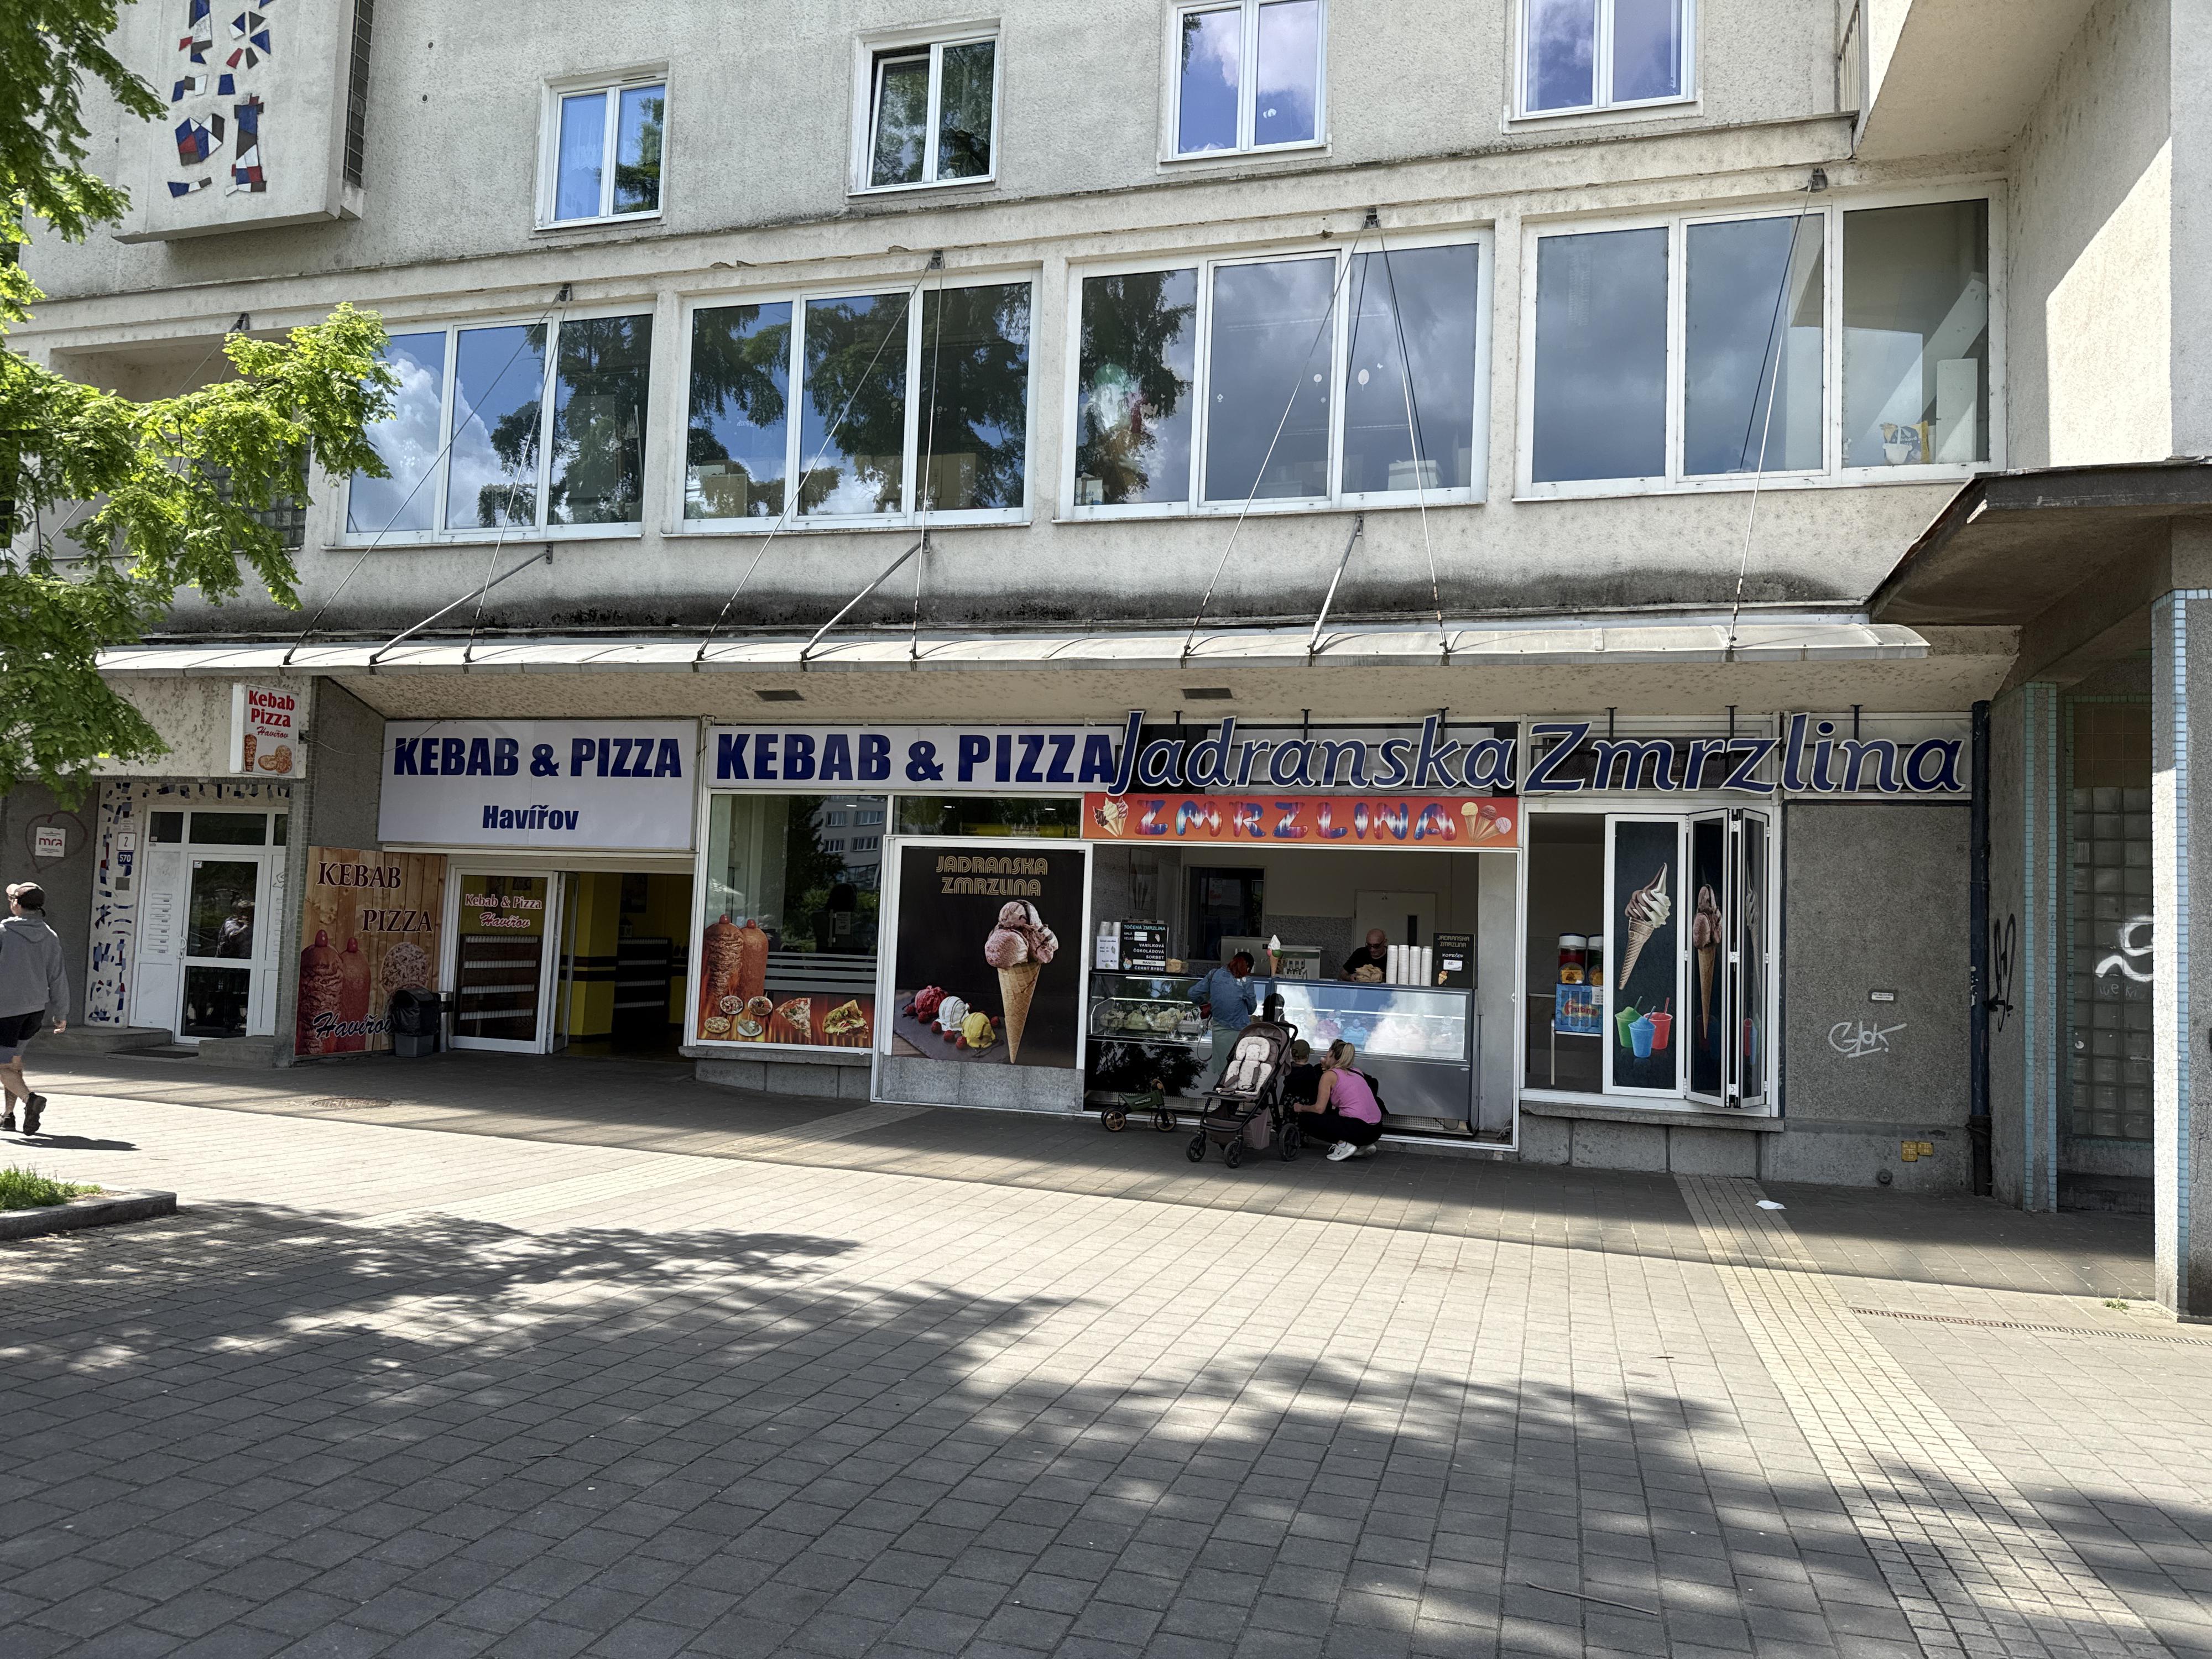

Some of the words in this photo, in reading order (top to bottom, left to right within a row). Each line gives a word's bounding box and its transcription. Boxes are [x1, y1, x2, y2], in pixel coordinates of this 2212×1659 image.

[249, 690, 295, 711] Kebab
[251, 708, 291, 727] Pizza
[394, 738, 519, 776] KEBAB
[530, 743, 560, 778] &
[570, 738, 682, 778] PIZZA
[716, 733, 891, 781] KEBAB
[905, 740, 943, 782] &
[957, 734, 1115, 783] PIZZA
[1107, 710, 1516, 797] Jadranska
[1522, 711, 1967, 795] Zmrzlina
[482, 805, 580, 831] Havířov
[1135, 799, 1458, 841] ZMRZLINA
[39, 838, 62, 846] mra
[124, 836, 128, 847] 2
[317, 862, 401, 889] KEBAB
[936, 855, 1048, 876] JADRANSKA
[941, 877, 1041, 896] ZMRZLINA
[465, 894, 498, 907] Kebab
[500, 896, 510, 907] &
[513, 896, 542, 909] Pizza
[362, 909, 434, 932] PIZZA
[479, 912, 530, 928] Havířov
